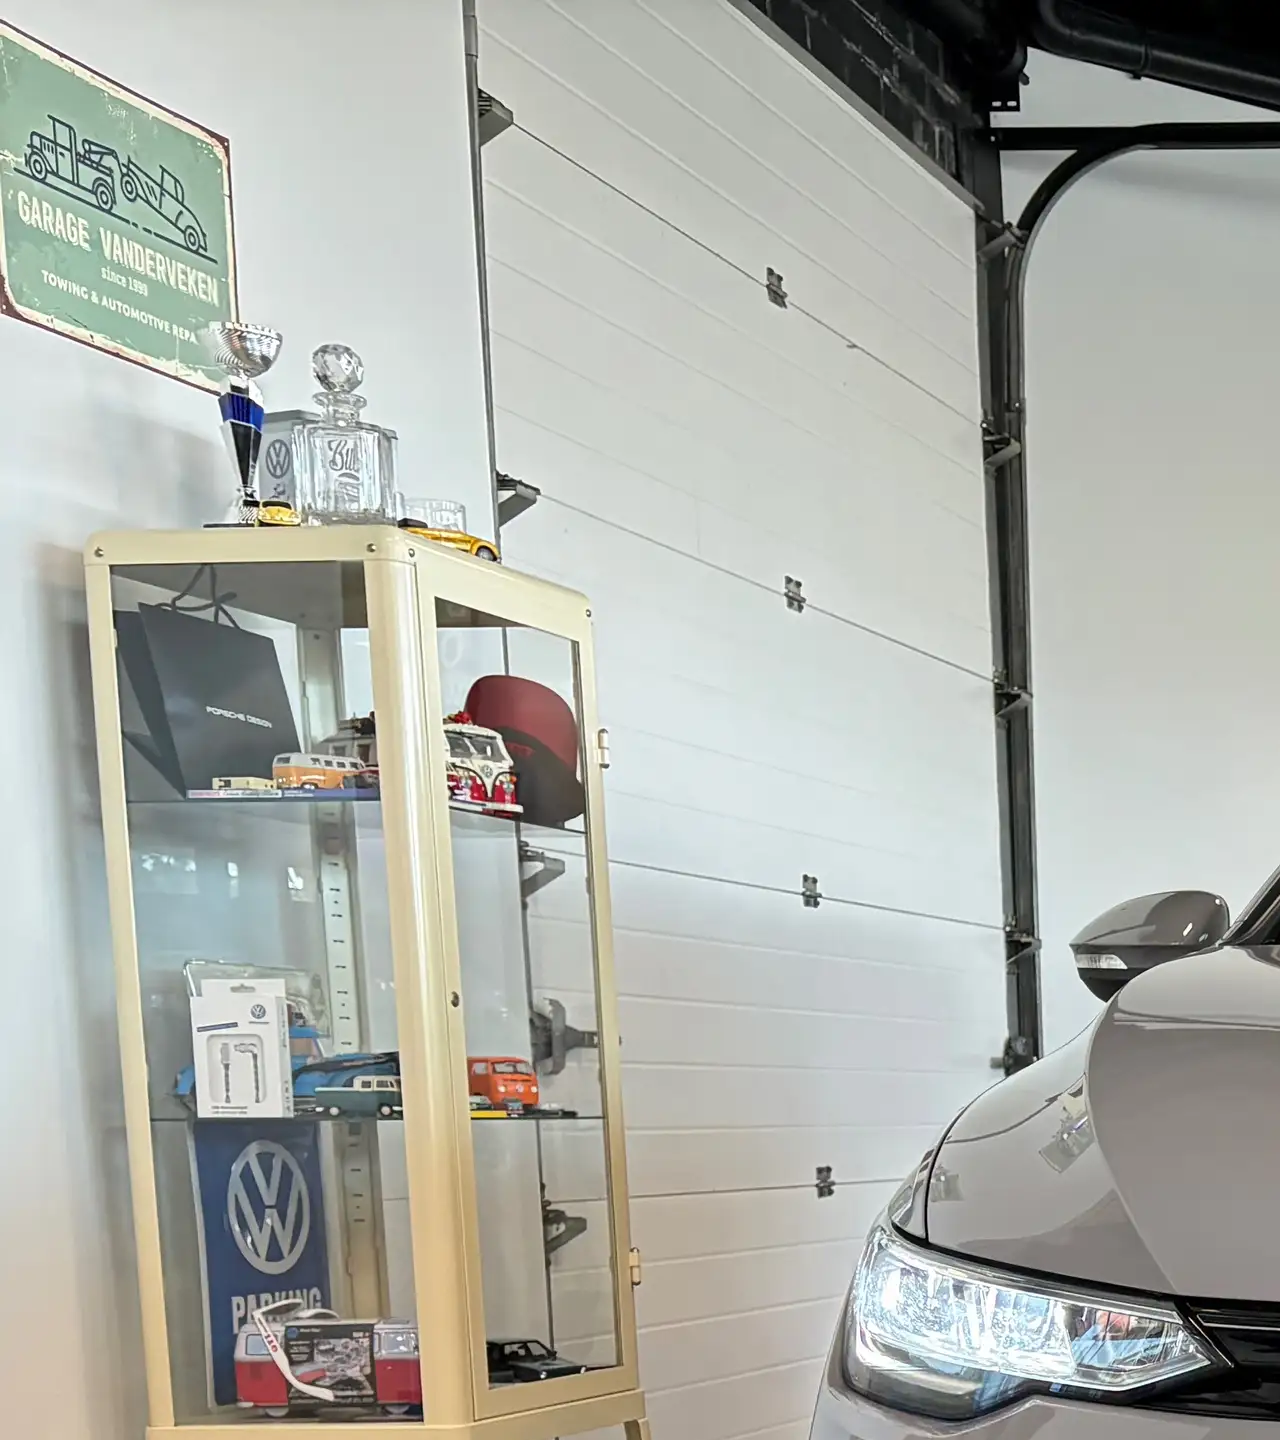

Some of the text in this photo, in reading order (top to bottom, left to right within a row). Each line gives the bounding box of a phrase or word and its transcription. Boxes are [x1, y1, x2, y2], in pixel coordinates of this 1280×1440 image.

[17, 190, 220, 308] GARAGE VANDERVEKEN
[101, 265, 127, 288] since
[41, 269, 200, 346] TOWING & AUTOMOTIVE REPA
